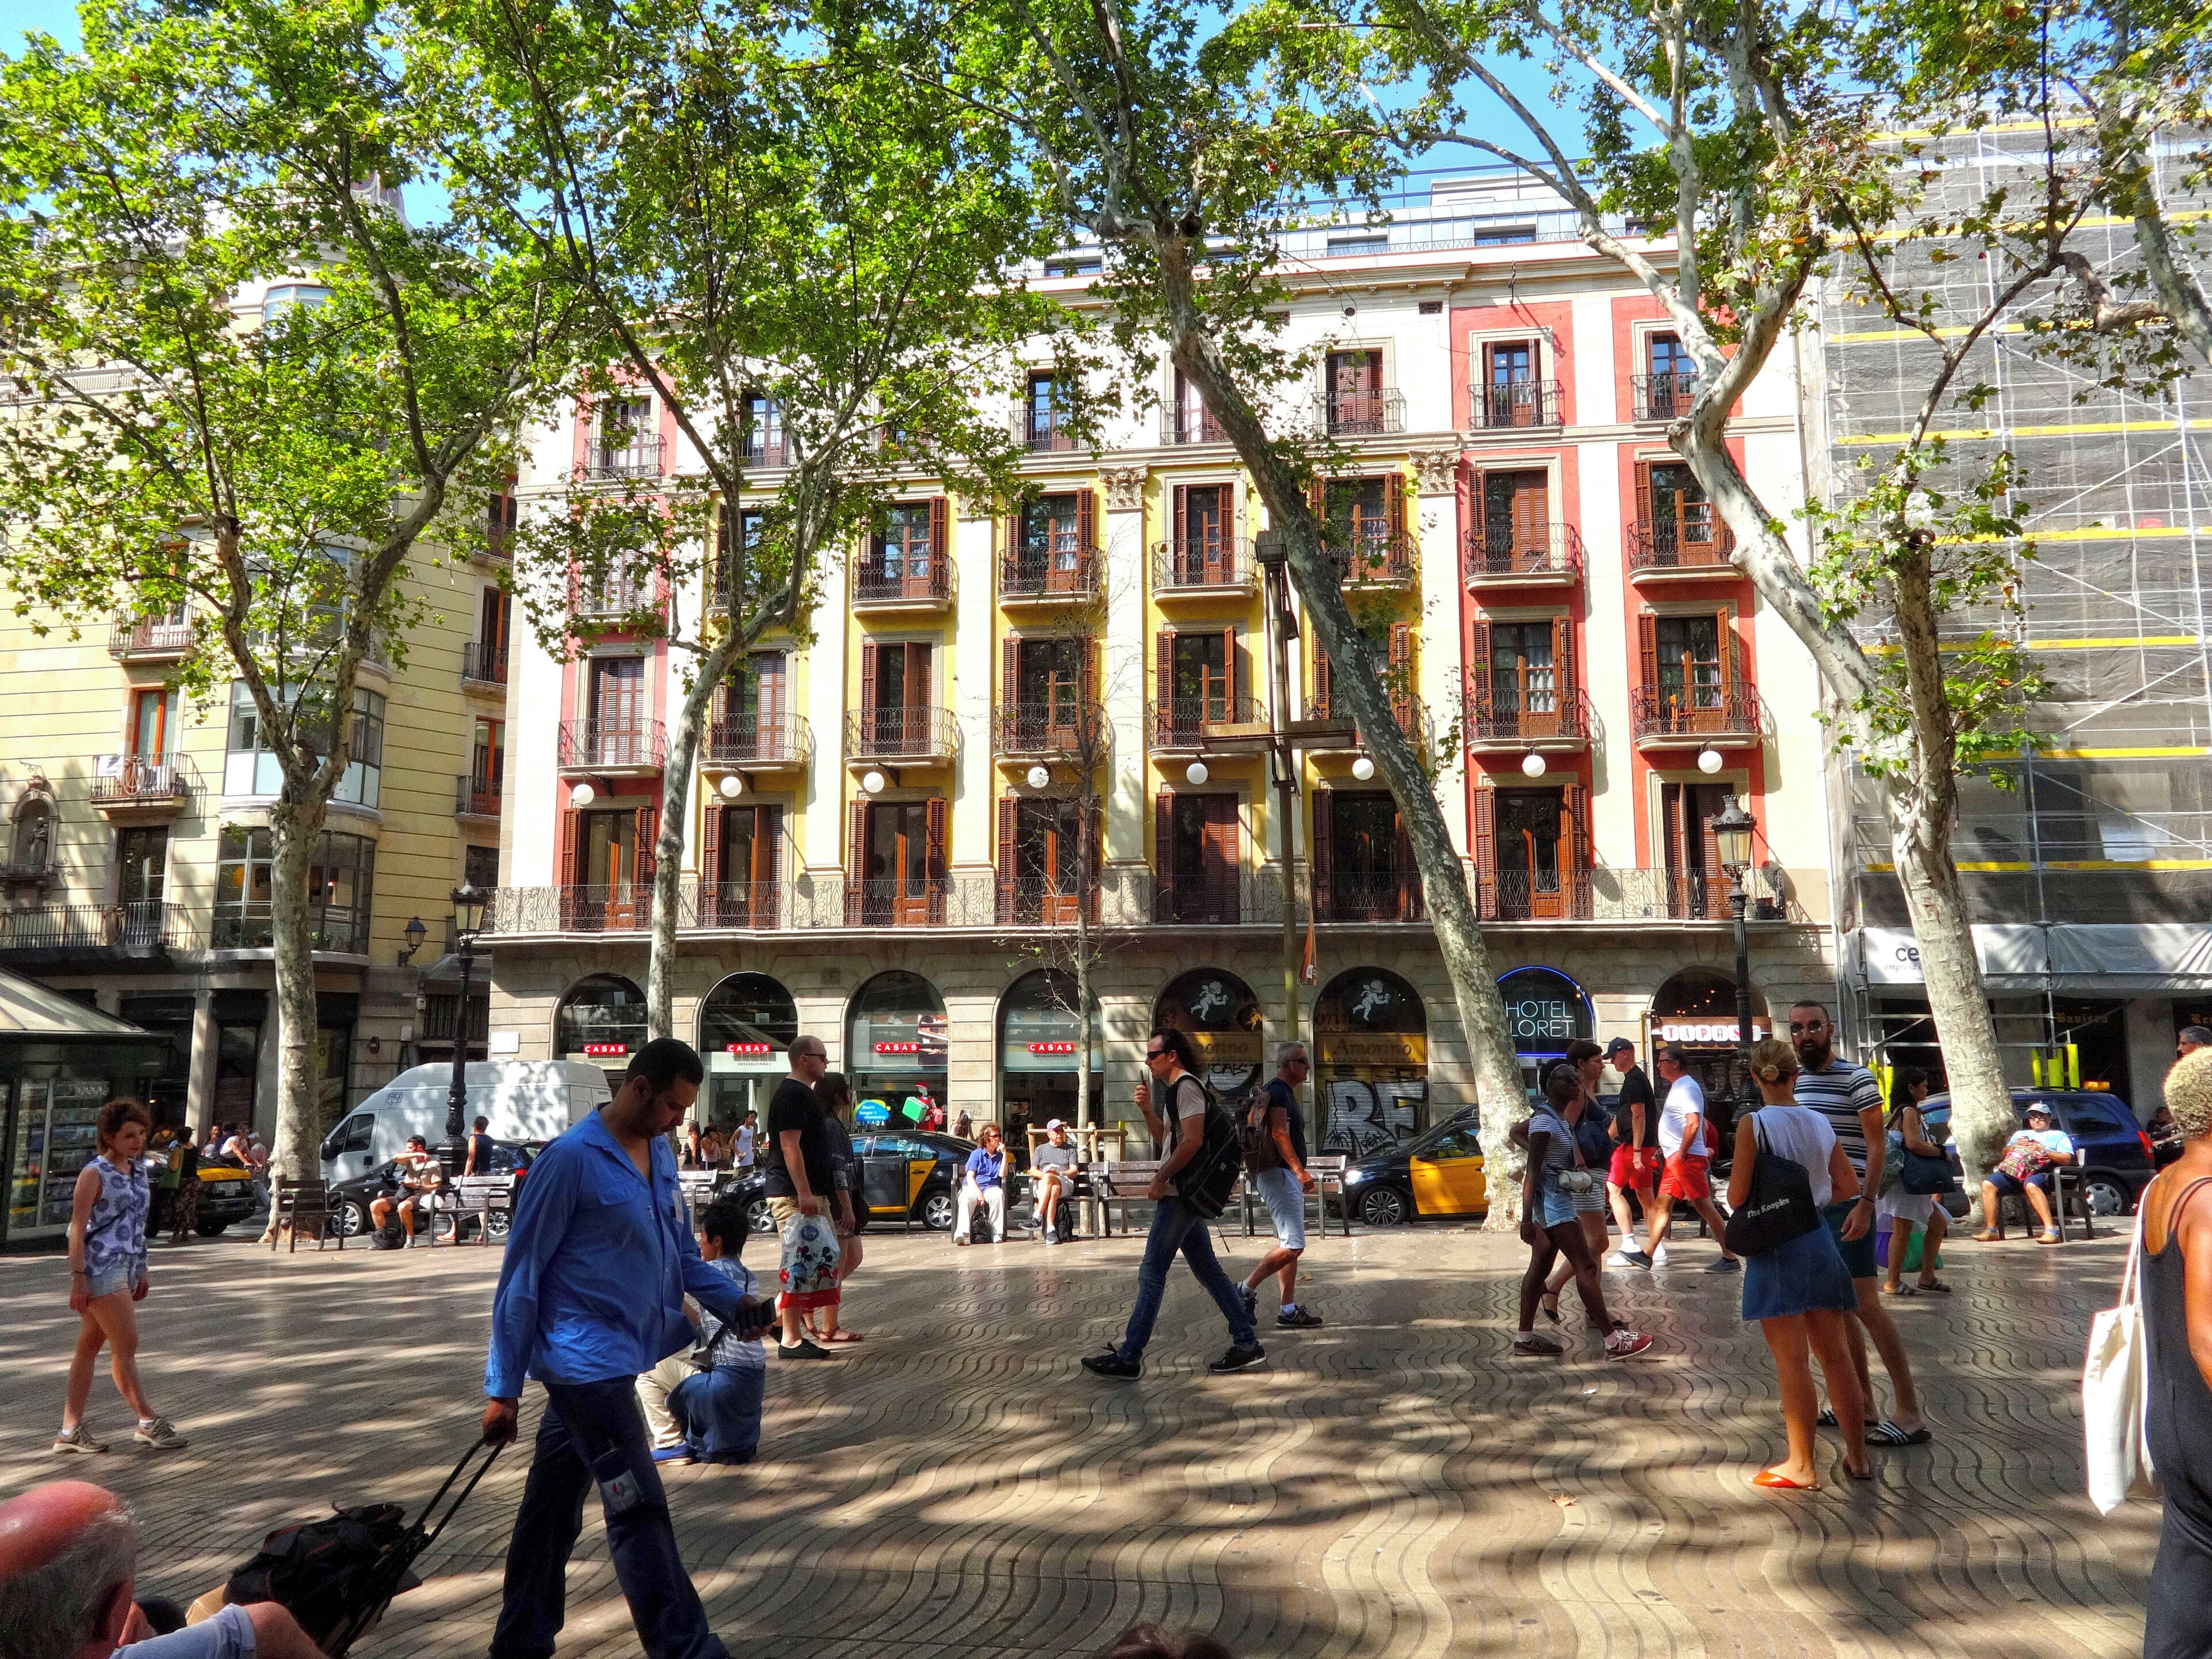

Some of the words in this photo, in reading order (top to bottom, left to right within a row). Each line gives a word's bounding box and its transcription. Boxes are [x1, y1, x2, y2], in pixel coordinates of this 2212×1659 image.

[1505, 1000, 1573, 1018] HOTEL
[584, 1045, 624, 1053] CASAS
[728, 1044, 768, 1052] CASAS
[875, 1043, 917, 1051] CASAS
[1029, 1044, 1072, 1052] CASAS
[1333, 1037, 1412, 1055] Amorino
[1747, 1209, 1761, 1218] The
[1760, 1198, 1790, 1214] Kooples
